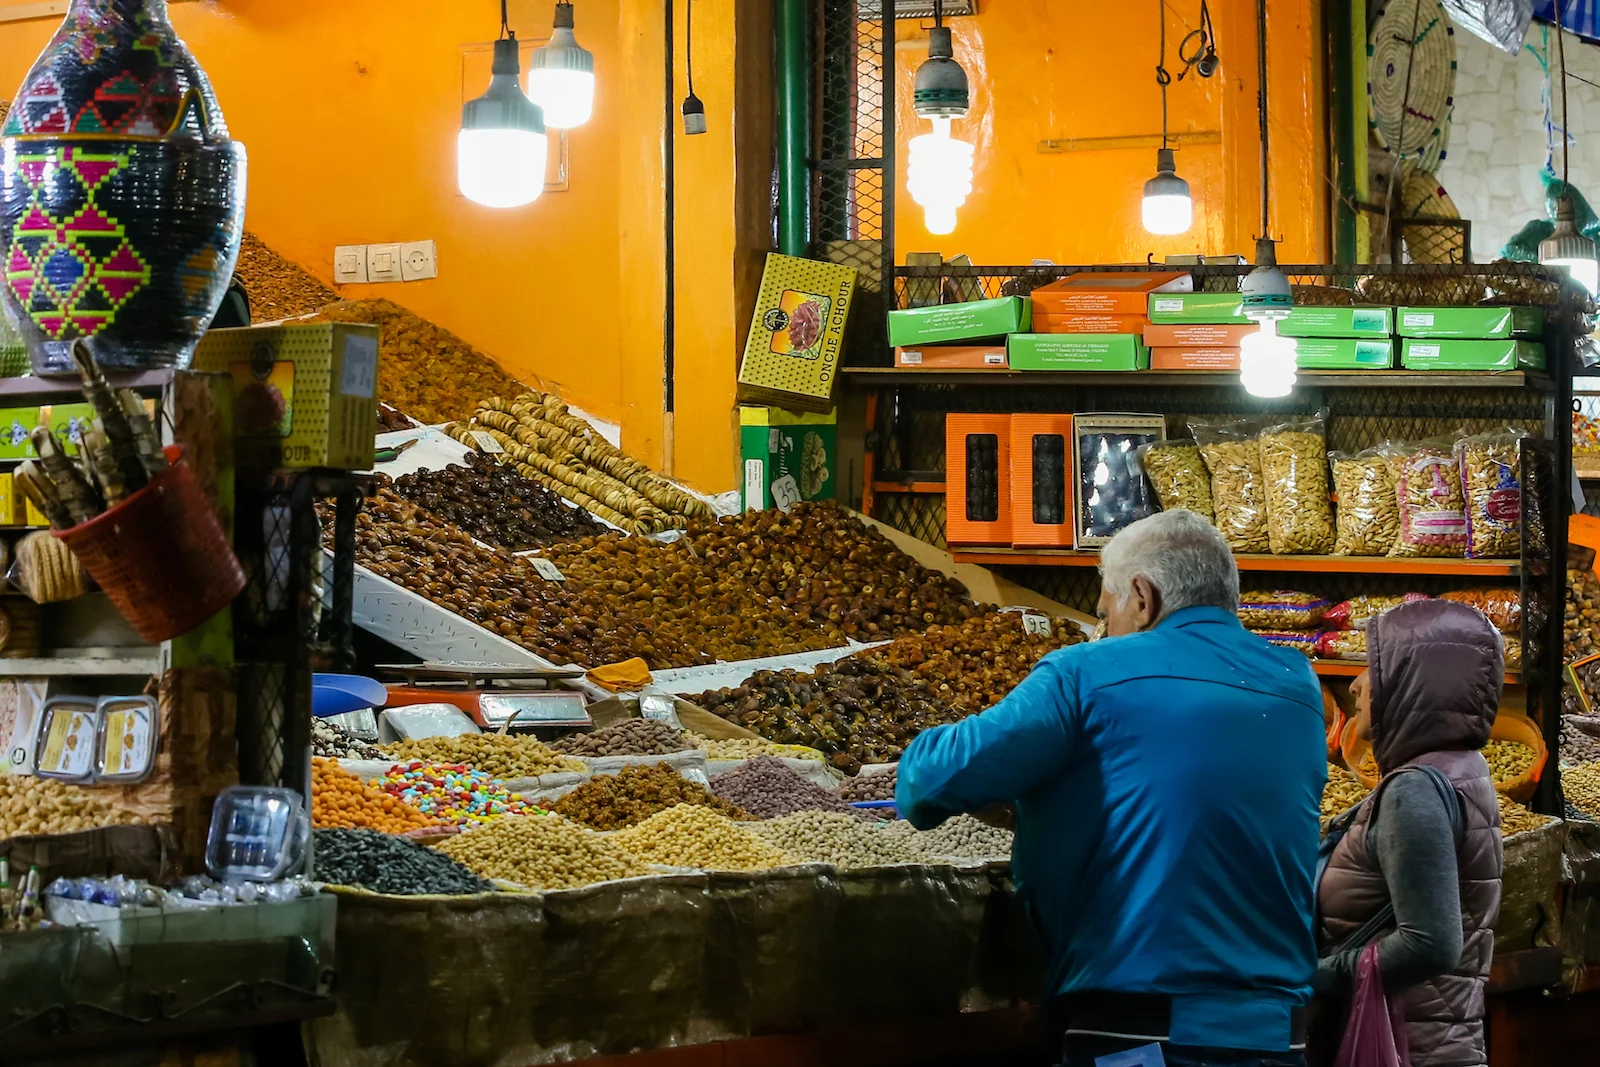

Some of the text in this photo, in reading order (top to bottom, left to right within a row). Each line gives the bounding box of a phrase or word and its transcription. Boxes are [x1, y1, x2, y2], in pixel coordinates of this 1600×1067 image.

[820, 280, 852, 382] ONCLE ACHOUR
[777, 481, 797, 508] 35
